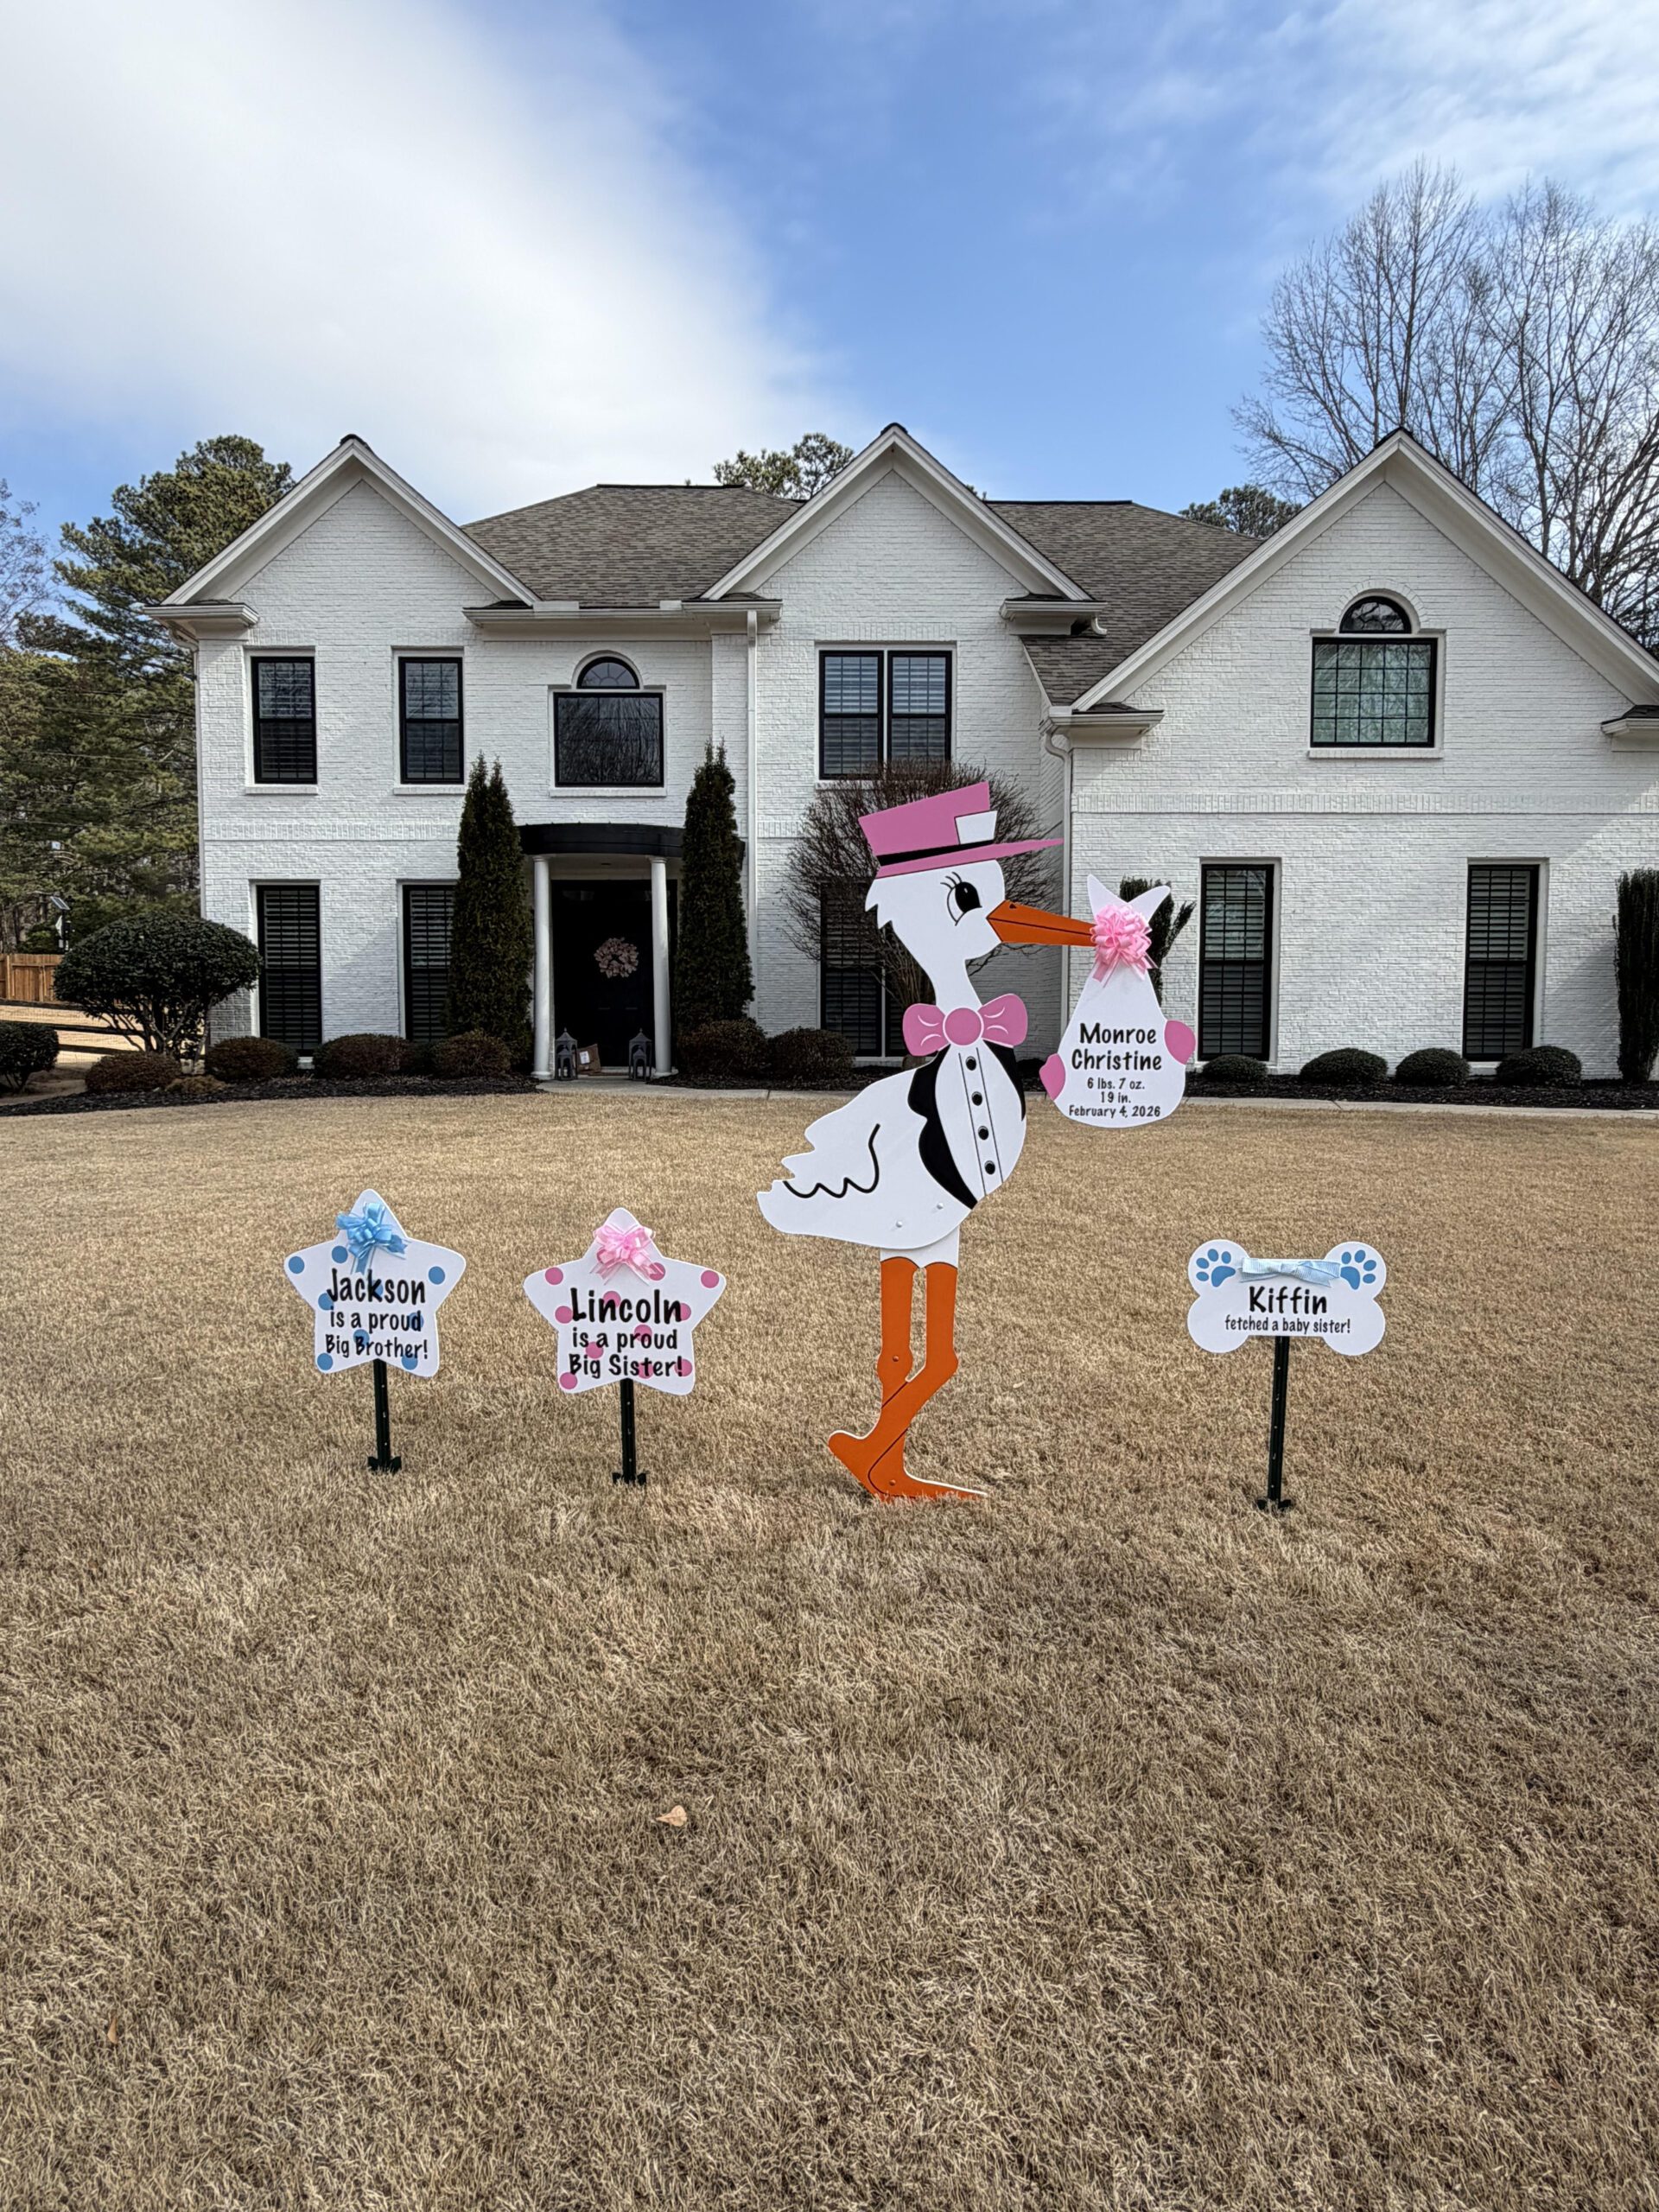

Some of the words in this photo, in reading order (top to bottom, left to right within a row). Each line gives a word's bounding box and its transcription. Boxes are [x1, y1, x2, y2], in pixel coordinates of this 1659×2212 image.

[1080, 1022, 1156, 1044] Monroe
[1071, 1048, 1162, 1071] Christine
[1087, 1077, 1094, 1090] 6
[1097, 1077, 1116, 1090] lbs.
[1118, 1077, 1127, 1090] 7
[1129, 1080, 1145, 1090] oz.
[1101, 1091, 1115, 1103] 19
[1117, 1092, 1131, 1103] in.
[1069, 1104, 1116, 1119] February
[1119, 1105, 1128, 1118] 4,
[1131, 1105, 1161, 1117] 2026
[327, 1268, 425, 1305] Jackson
[570, 1287, 682, 1325] Lincoln
[1249, 1286, 1327, 1315] Kiffin
[330, 1306, 345, 1327] is
[350, 1312, 362, 1329] a
[368, 1310, 422, 1334] proud
[1224, 1314, 1268, 1331] fetched
[1271, 1320, 1279, 1332] a
[1282, 1317, 1310, 1335] baby
[1313, 1318, 1351, 1333] sister!
[325, 1333, 350, 1358] Big
[354, 1335, 428, 1359] Brother!
[572, 1326, 589, 1348] is
[596, 1332, 609, 1349] a
[617, 1329, 677, 1353] proud
[569, 1353, 601, 1379] Big
[608, 1353, 683, 1377] Sister!
